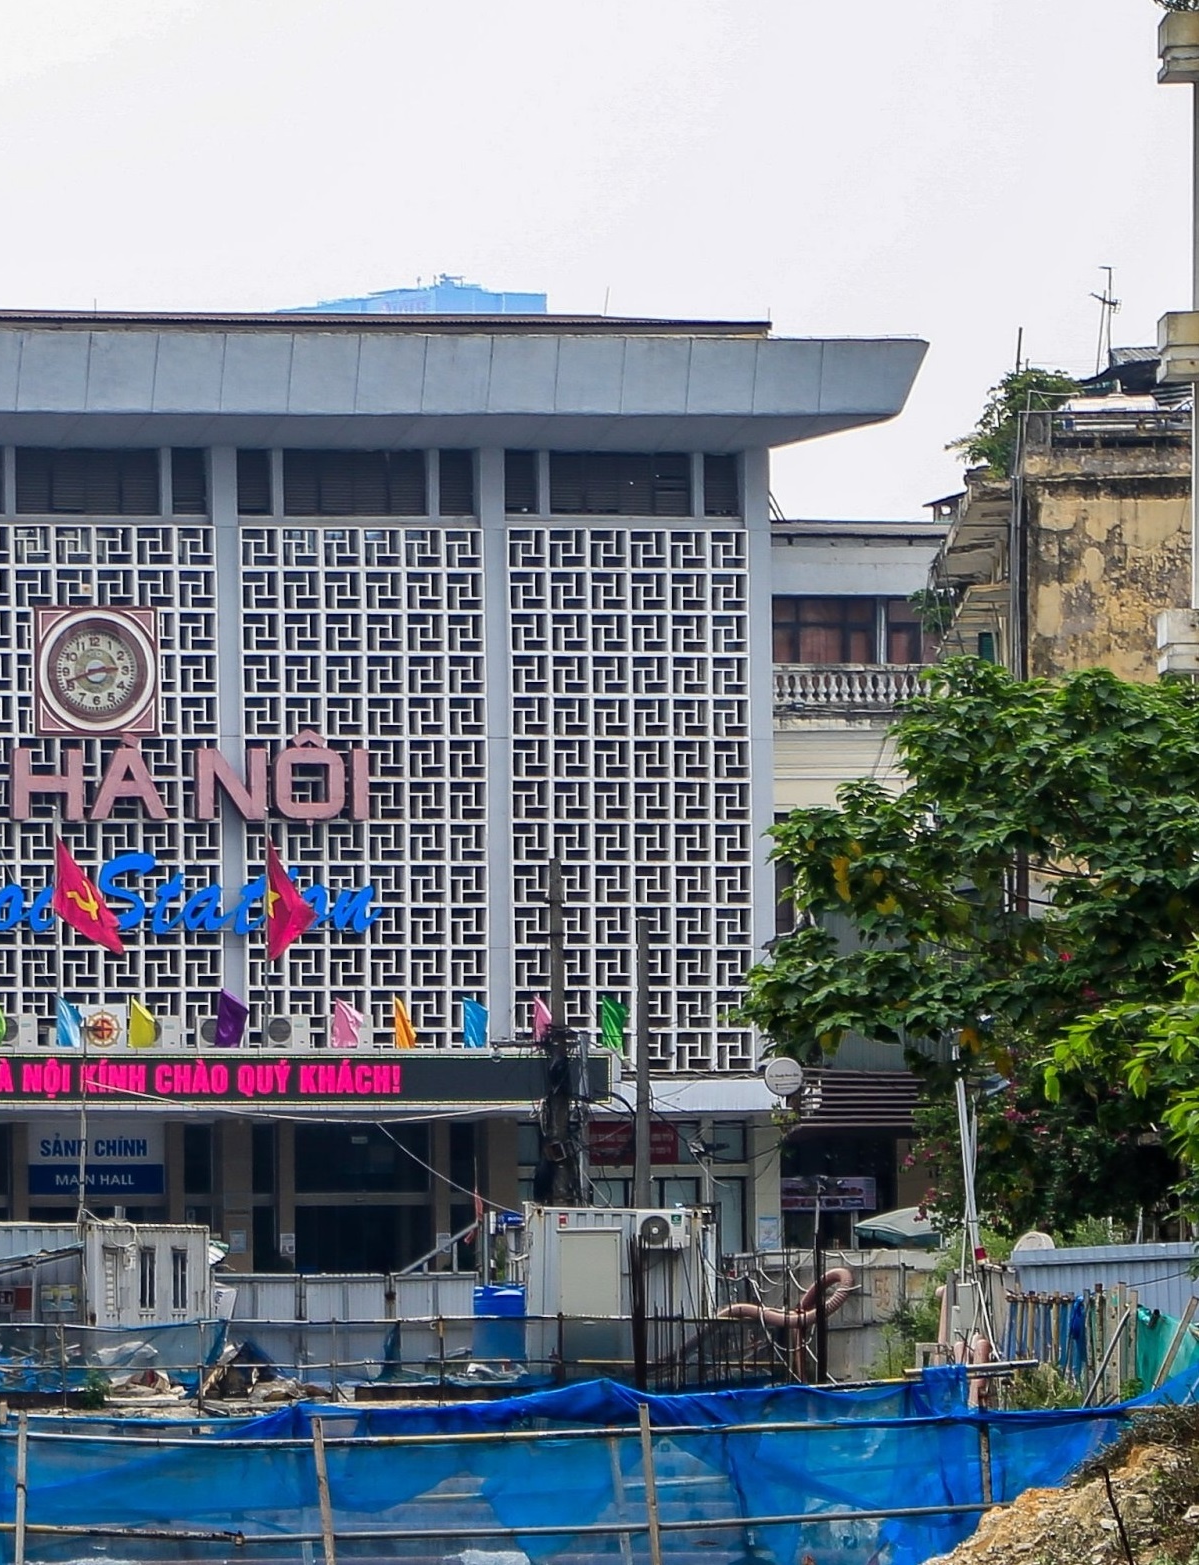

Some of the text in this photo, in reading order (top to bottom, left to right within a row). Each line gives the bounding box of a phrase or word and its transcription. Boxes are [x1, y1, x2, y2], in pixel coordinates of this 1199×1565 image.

[76, 642, 85, 650] 11
[89, 637, 100, 646] 12
[108, 641, 112, 650] 1
[66, 652, 77, 661] 10
[117, 651, 125, 661] 2
[63, 667, 70, 676] 9
[121, 666, 129, 676] 3
[117, 681, 126, 690] 4
[79, 693, 87, 702] 7
[93, 696, 100, 705] 6
[108, 692, 115, 702] 5
[10, 733, 169, 822] HÀ
[98, 852, 384, 936] Staton
[22, 1057, 71, 1099] NỘI
[80, 1058, 146, 1093] KÍNH
[155, 1059, 229, 1094] CHÀO
[237, 1059, 292, 1097] QUÝ
[299, 1059, 402, 1094] KHÁCH!
[94, 1135, 148, 1157] CHÍNH
[55, 1174, 135, 1186] MAN HALL
